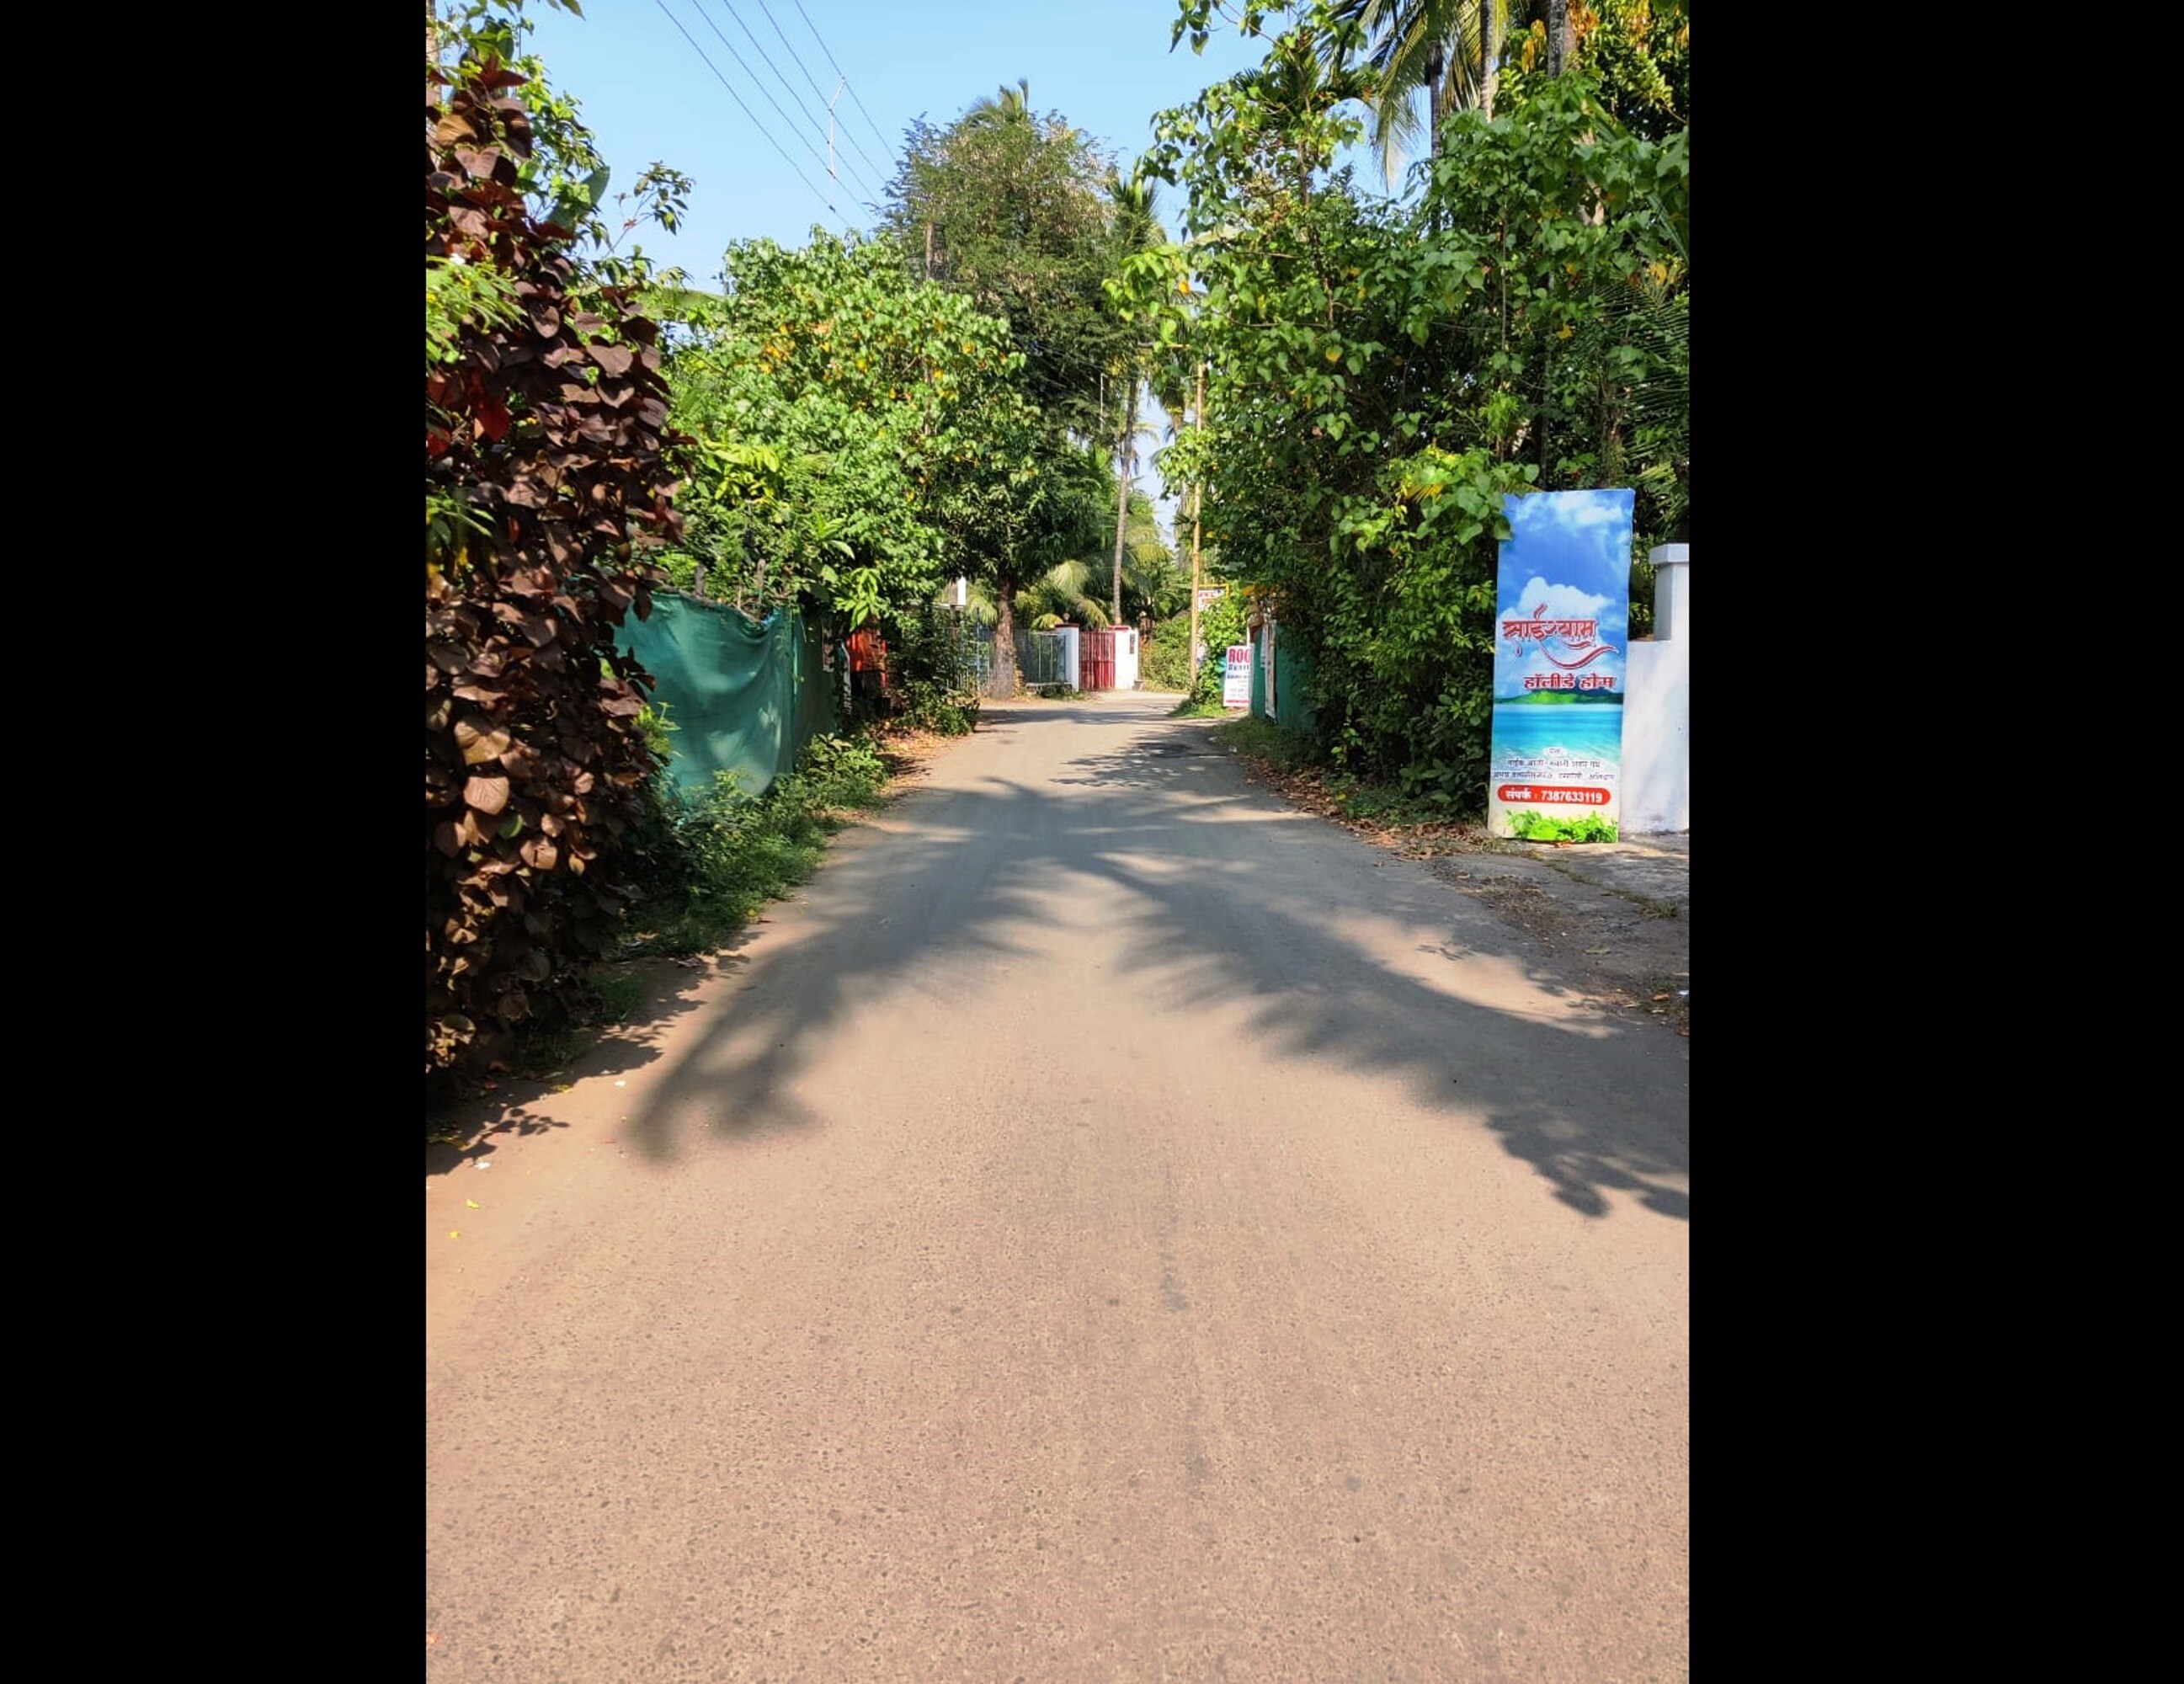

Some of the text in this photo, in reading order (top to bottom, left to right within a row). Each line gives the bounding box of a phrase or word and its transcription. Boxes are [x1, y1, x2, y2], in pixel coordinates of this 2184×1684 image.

[1524, 673, 1617, 690] हॉलीडे होम
[1505, 787, 1532, 800] संपर्क
[1541, 790, 1603, 803] 7387633119
